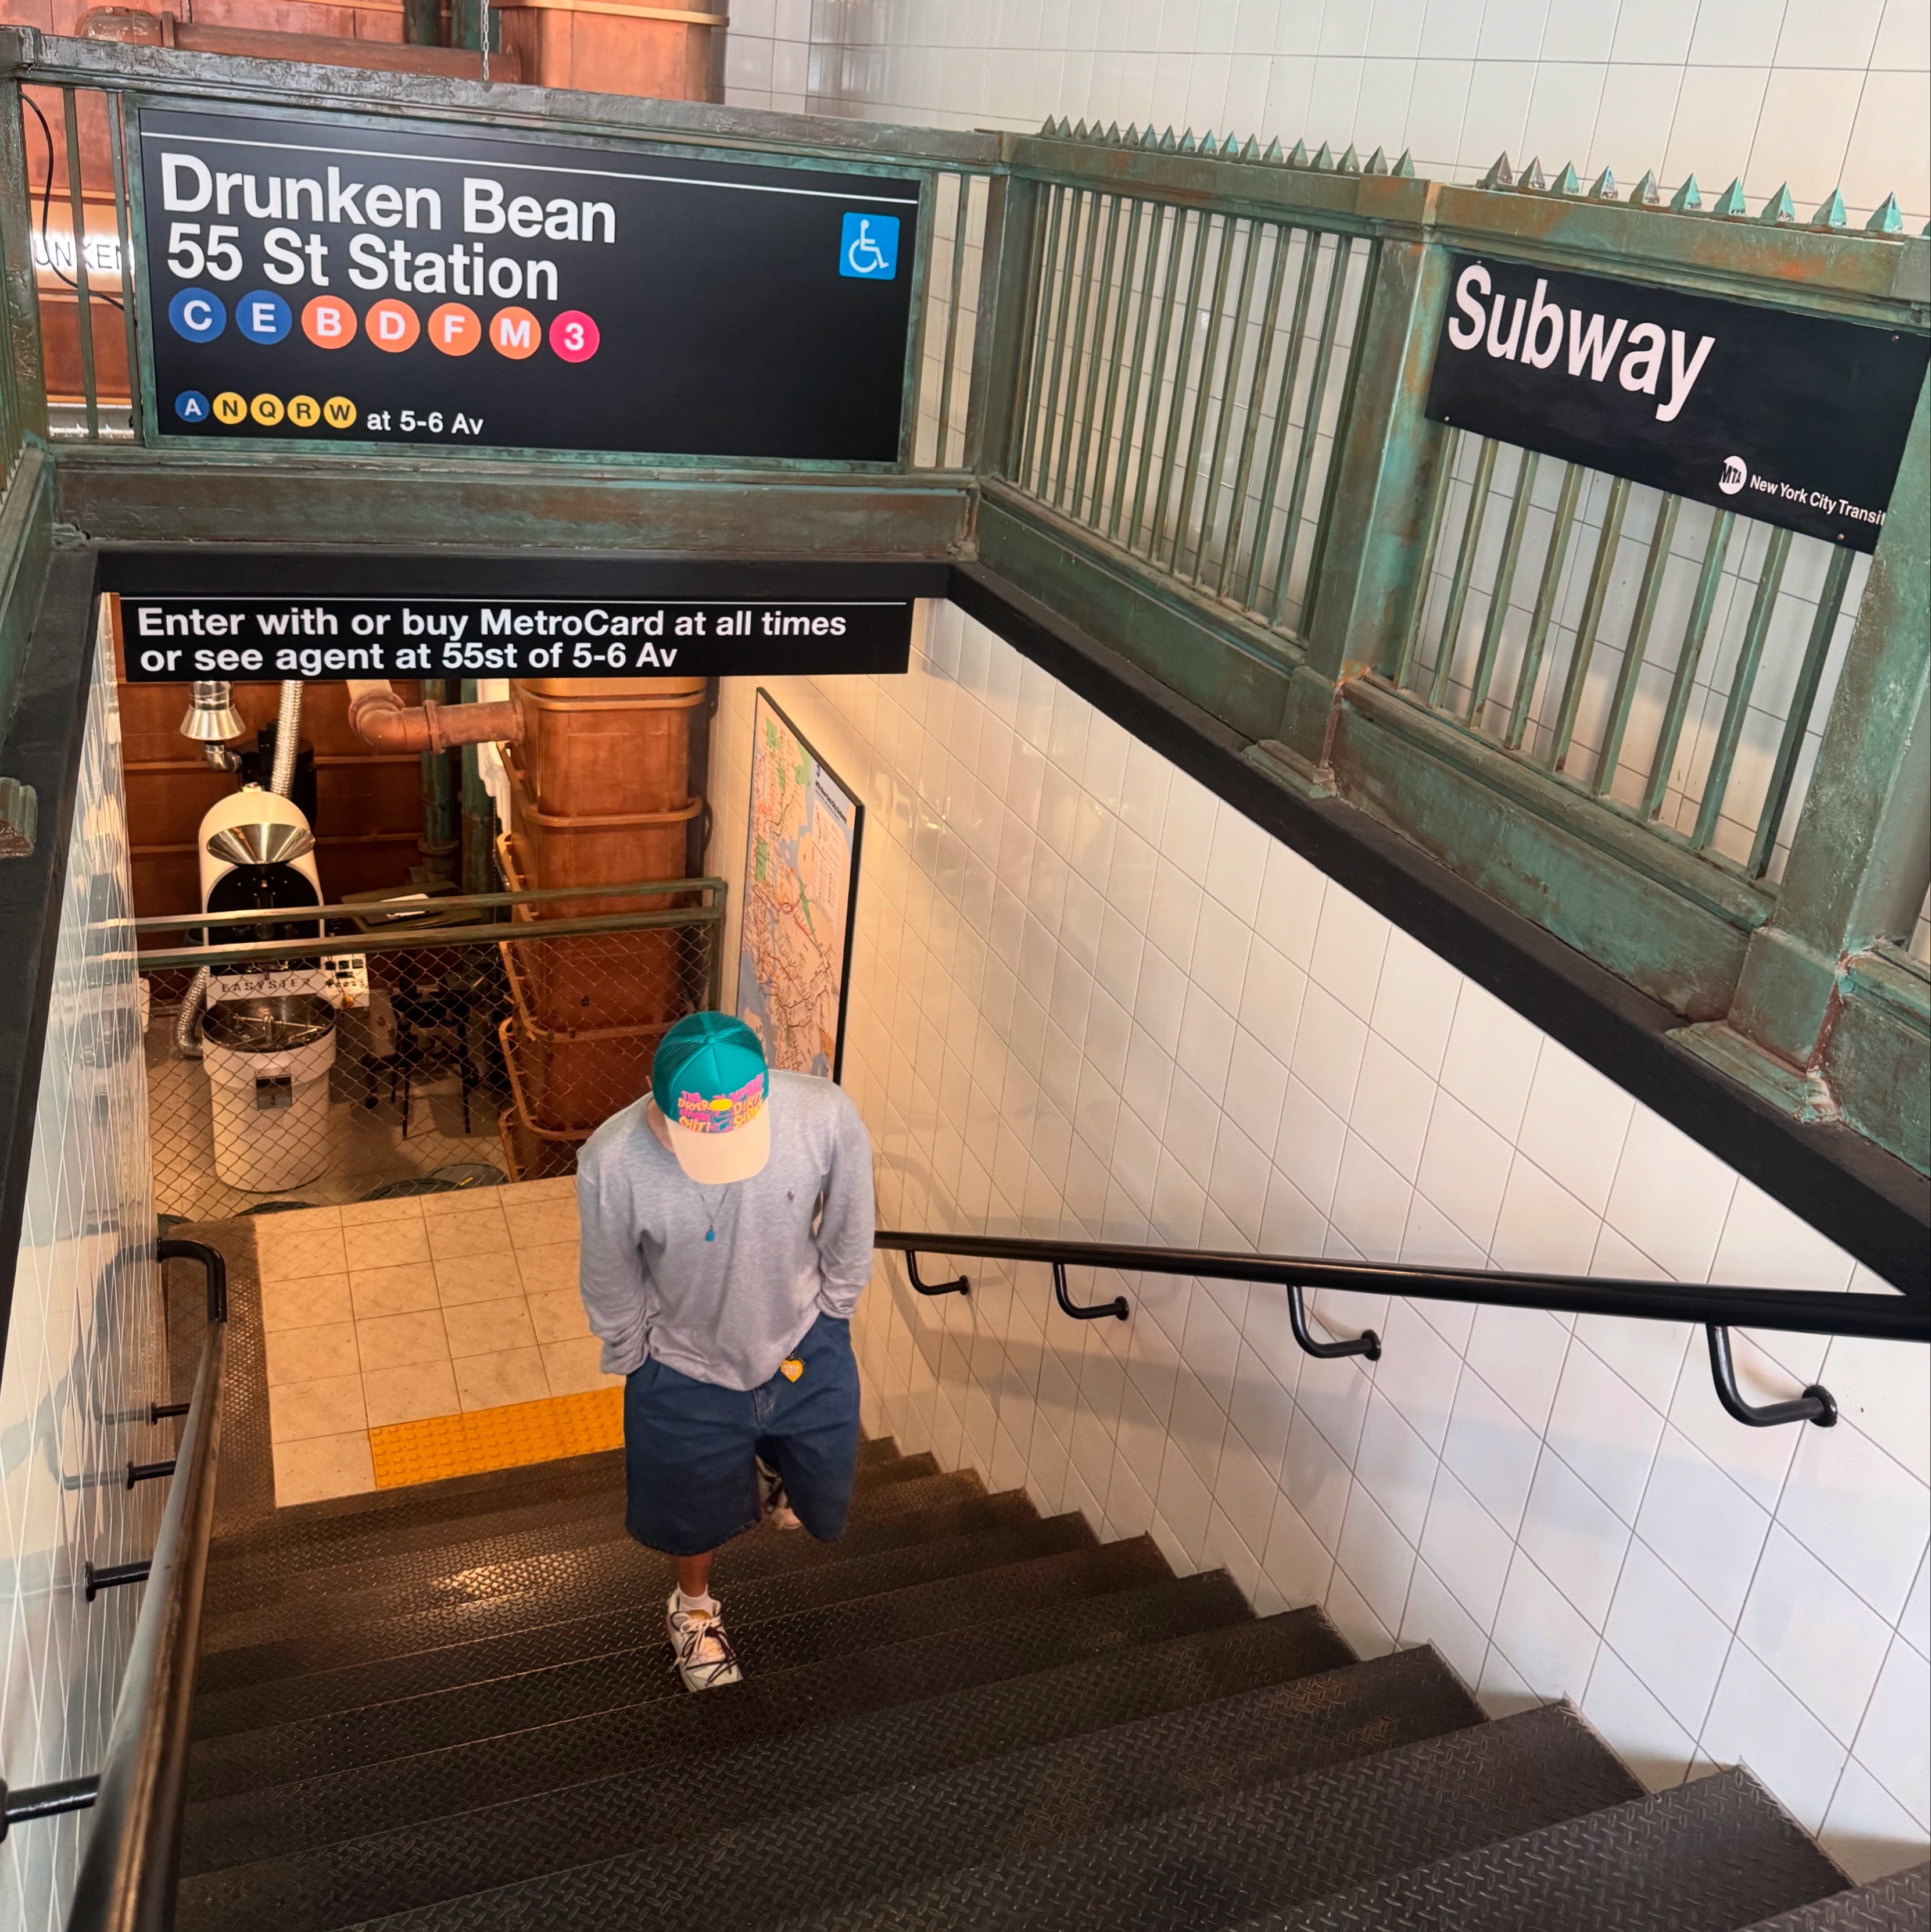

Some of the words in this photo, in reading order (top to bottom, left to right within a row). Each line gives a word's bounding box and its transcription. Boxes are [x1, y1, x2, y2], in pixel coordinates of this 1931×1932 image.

[161, 152, 442, 231] Drunken
[463, 177, 616, 244] Bean
[167, 222, 243, 281] 55
[263, 227, 329, 287] St
[348, 233, 558, 300] Station
[184, 300, 213, 331] C
[252, 302, 277, 332] E
[317, 306, 342, 337] B
[379, 310, 406, 341] D
[444, 314, 465, 344] F
[500, 317, 531, 348] M
[564, 323, 585, 351] 3
[1448, 264, 1716, 423] Subway
[184, 398, 202, 416] A
[223, 400, 238, 417] N
[259, 401, 276, 418] Q
[296, 403, 311, 420] R
[329, 404, 351, 421] W
[367, 411, 391, 431] at
[400, 410, 444, 433] 5-6
[451, 413, 484, 435] Av
[1750, 474, 1779, 495] New
[1780, 482, 1808, 504] York
[1810, 492, 1837, 515] City
[138, 607, 246, 636] Enter
[256, 607, 339, 635] with
[352, 614, 391, 635] or
[403, 608, 470, 641] buy
[481, 609, 664, 636] MetroCard
[675, 611, 707, 636] at
[716, 610, 752, 636] all
[761, 610, 847, 636] times
[141, 650, 182, 672] or
[195, 649, 263, 671] see
[276, 643, 385, 676] agent
[396, 643, 431, 670] at
[442, 642, 518, 669] 55st
[528, 642, 563, 668] of
[572, 642, 626, 668] 5-6
[636, 642, 678, 668] Av
[678, 1097, 711, 1111] DRYER
